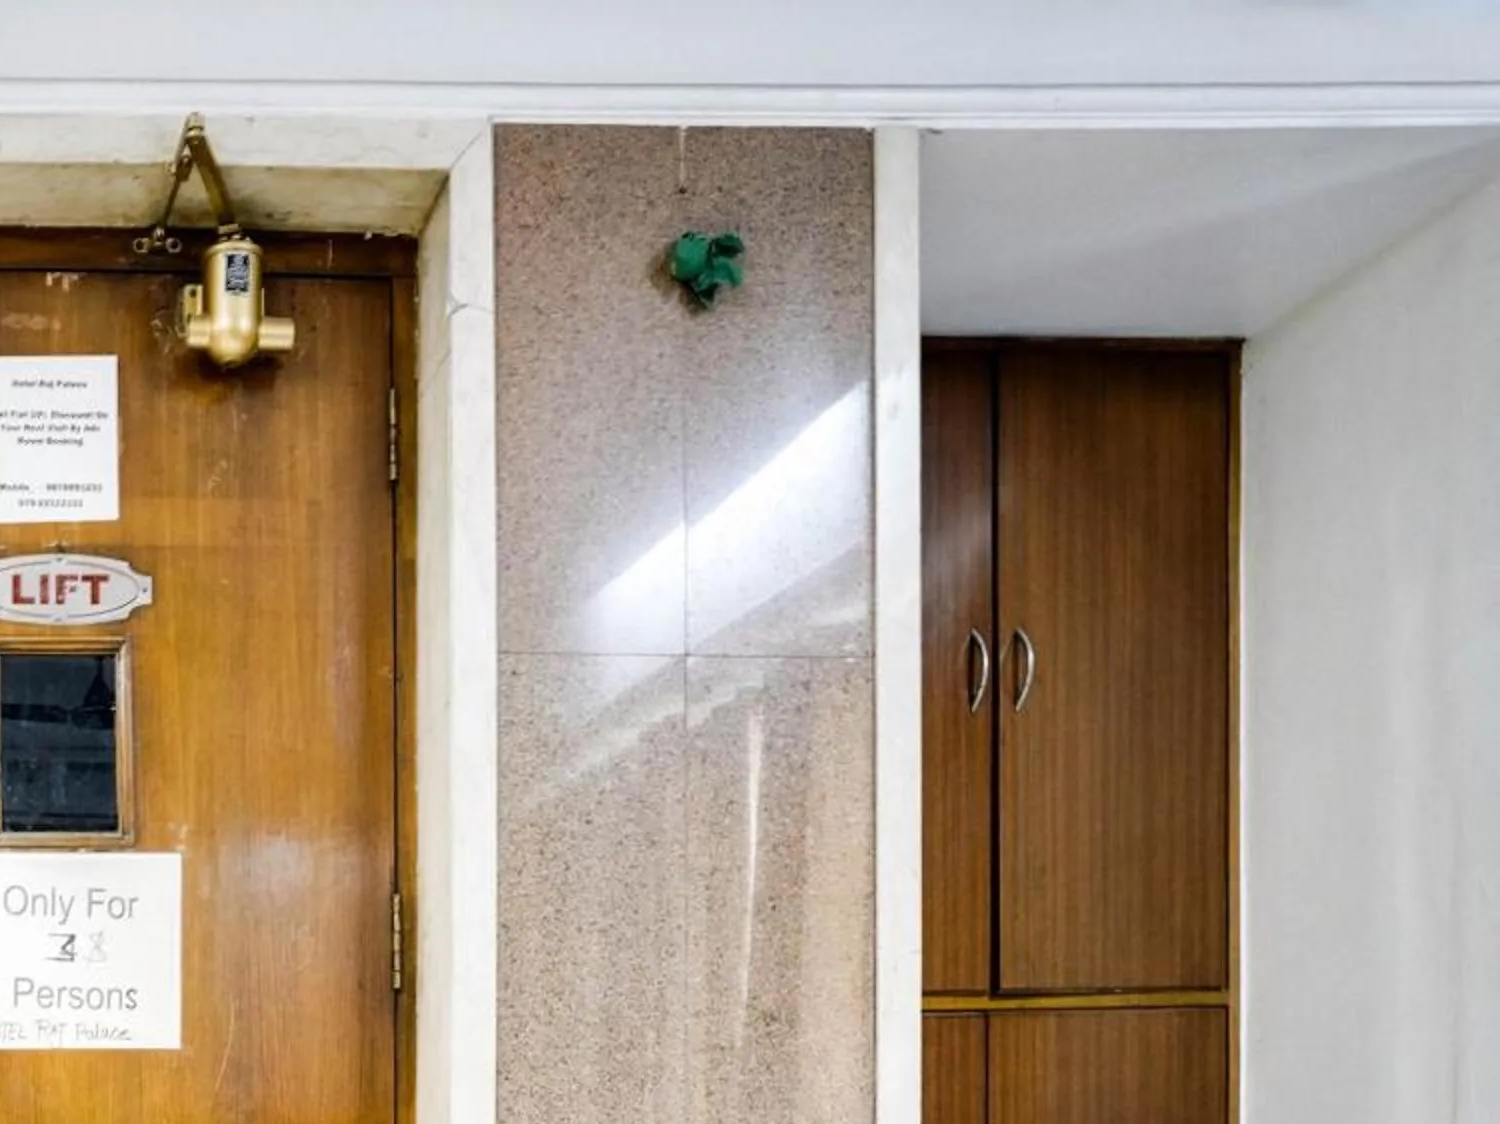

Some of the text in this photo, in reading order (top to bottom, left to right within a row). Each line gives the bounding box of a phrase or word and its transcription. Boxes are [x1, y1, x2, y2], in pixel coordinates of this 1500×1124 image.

[11, 574, 110, 605] LIFT
[3, 884, 139, 926] Only For
[13, 976, 139, 1011] Persons
